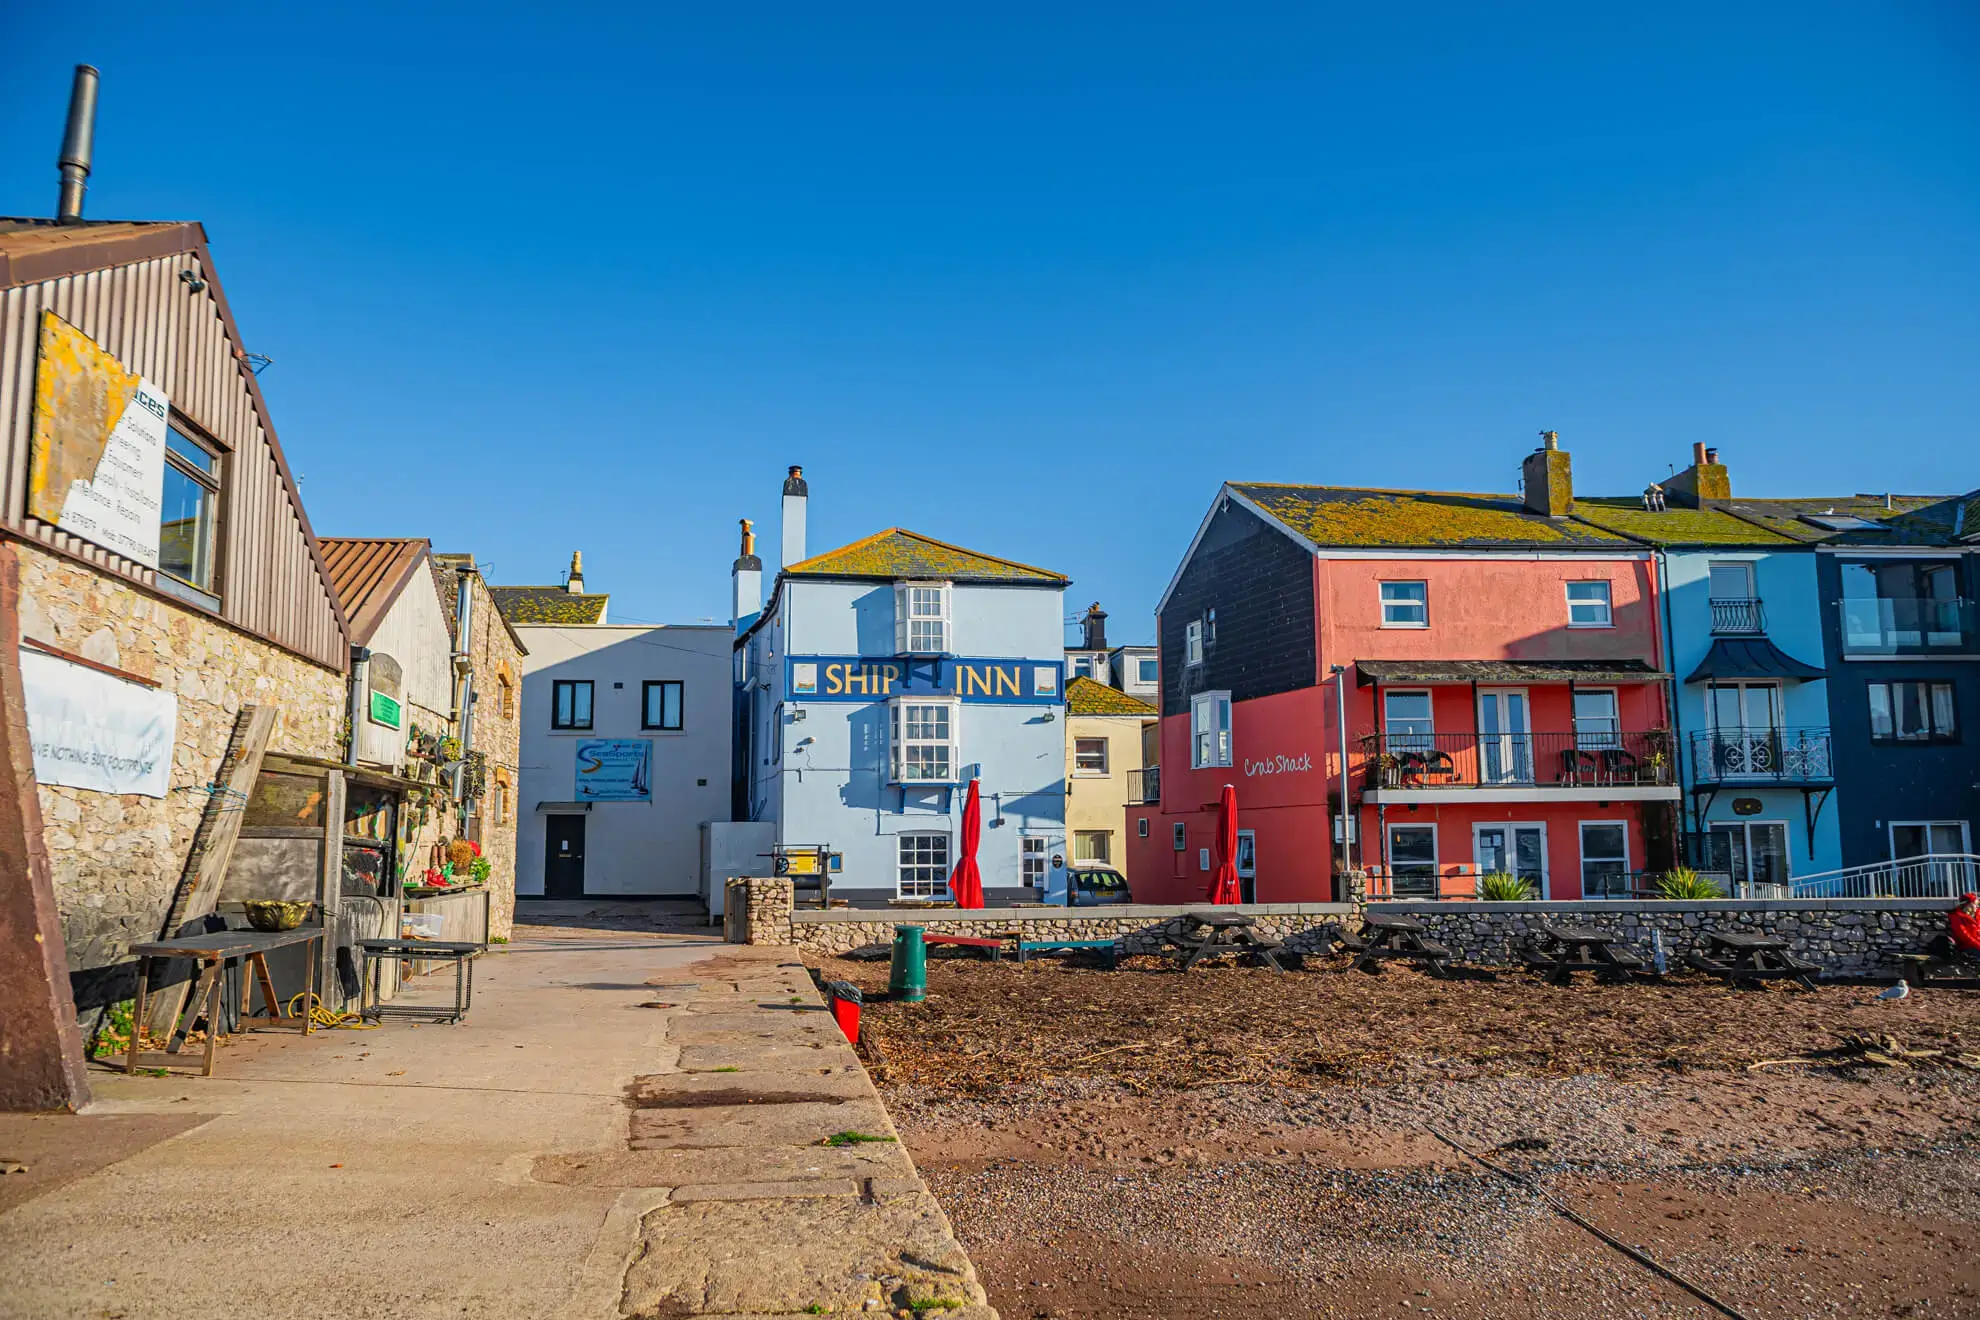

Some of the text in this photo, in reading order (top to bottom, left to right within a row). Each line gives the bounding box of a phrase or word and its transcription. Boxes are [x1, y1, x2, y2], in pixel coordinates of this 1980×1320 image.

[825, 664, 1021, 696] SHIP INN
[51, 746, 89, 765] NOTHING
[91, 751, 107, 768] BUT
[1244, 752, 1312, 777] Crab Shack
